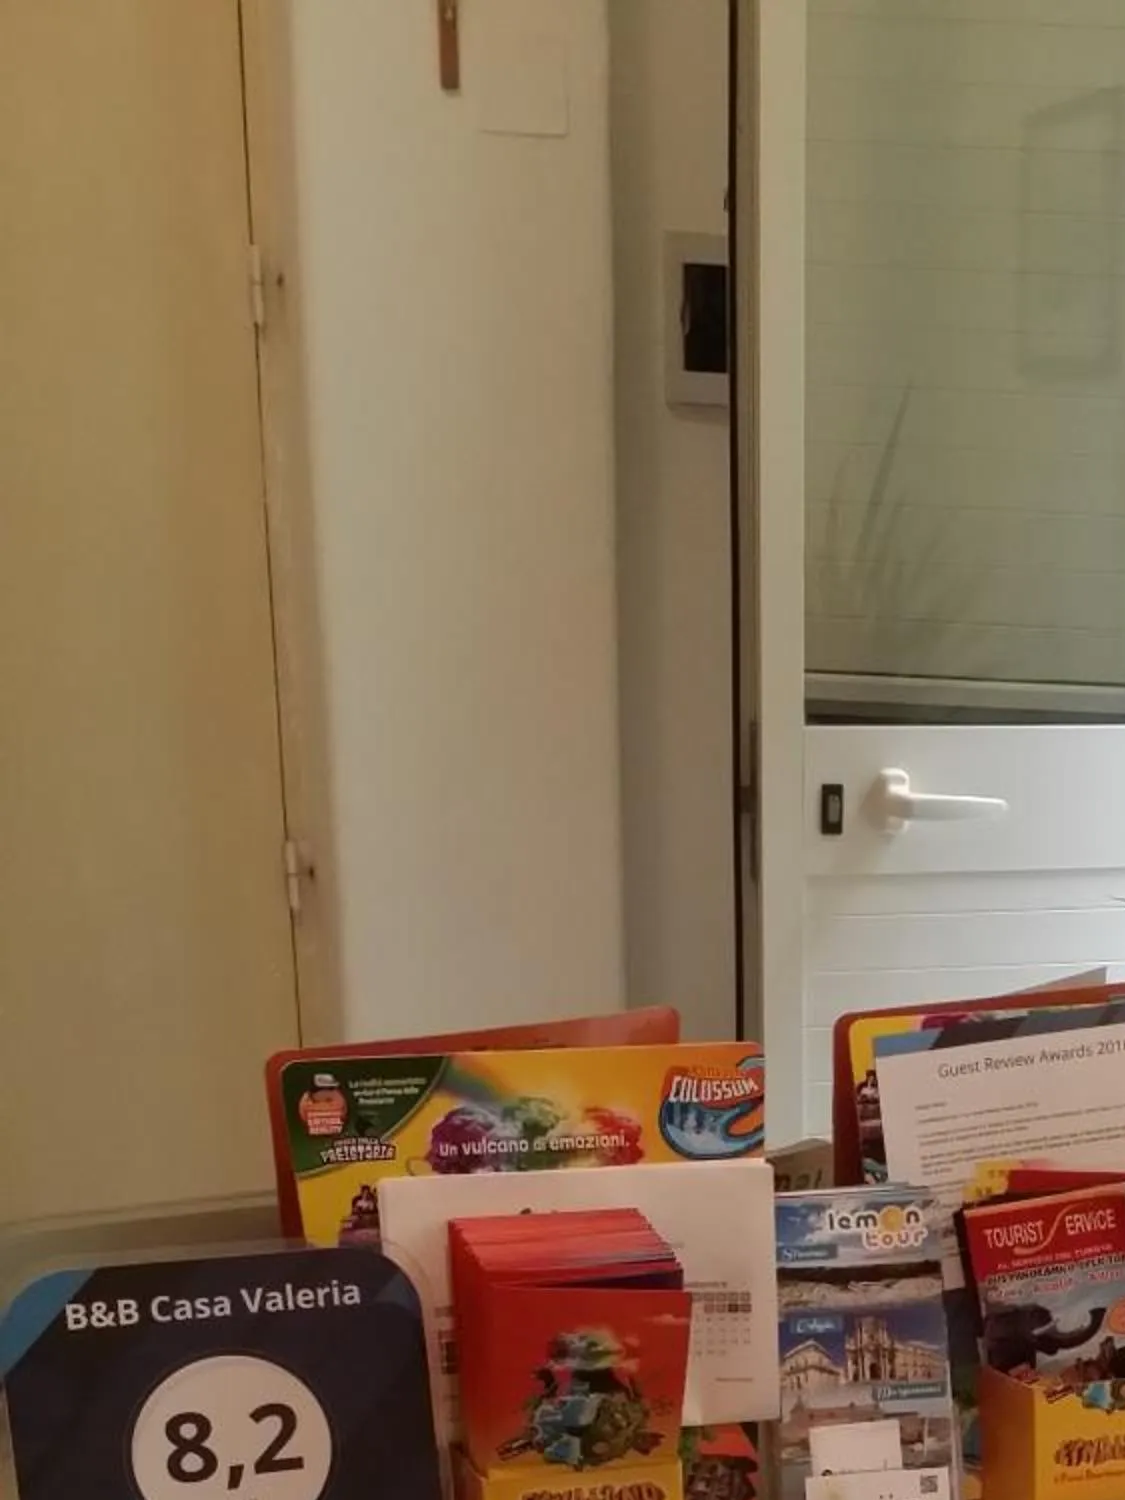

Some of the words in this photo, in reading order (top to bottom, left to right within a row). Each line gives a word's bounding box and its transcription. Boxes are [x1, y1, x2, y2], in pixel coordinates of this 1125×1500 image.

[937, 1060, 981, 1079] Guest
[983, 1055, 1036, 1072] Review
[1039, 1047, 1094, 1063] Awards
[438, 1143, 459, 1158] Un
[461, 1134, 529, 1156] vulcano
[827, 1206, 921, 1231] lemon
[865, 1229, 927, 1249] tour
[983, 1220, 1045, 1249] TOURIST
[65, 1299, 140, 1331] B&B
[151, 1295, 232, 1322] Casa
[240, 1280, 362, 1315] Valeria
[165, 1403, 304, 1491] 8,2
